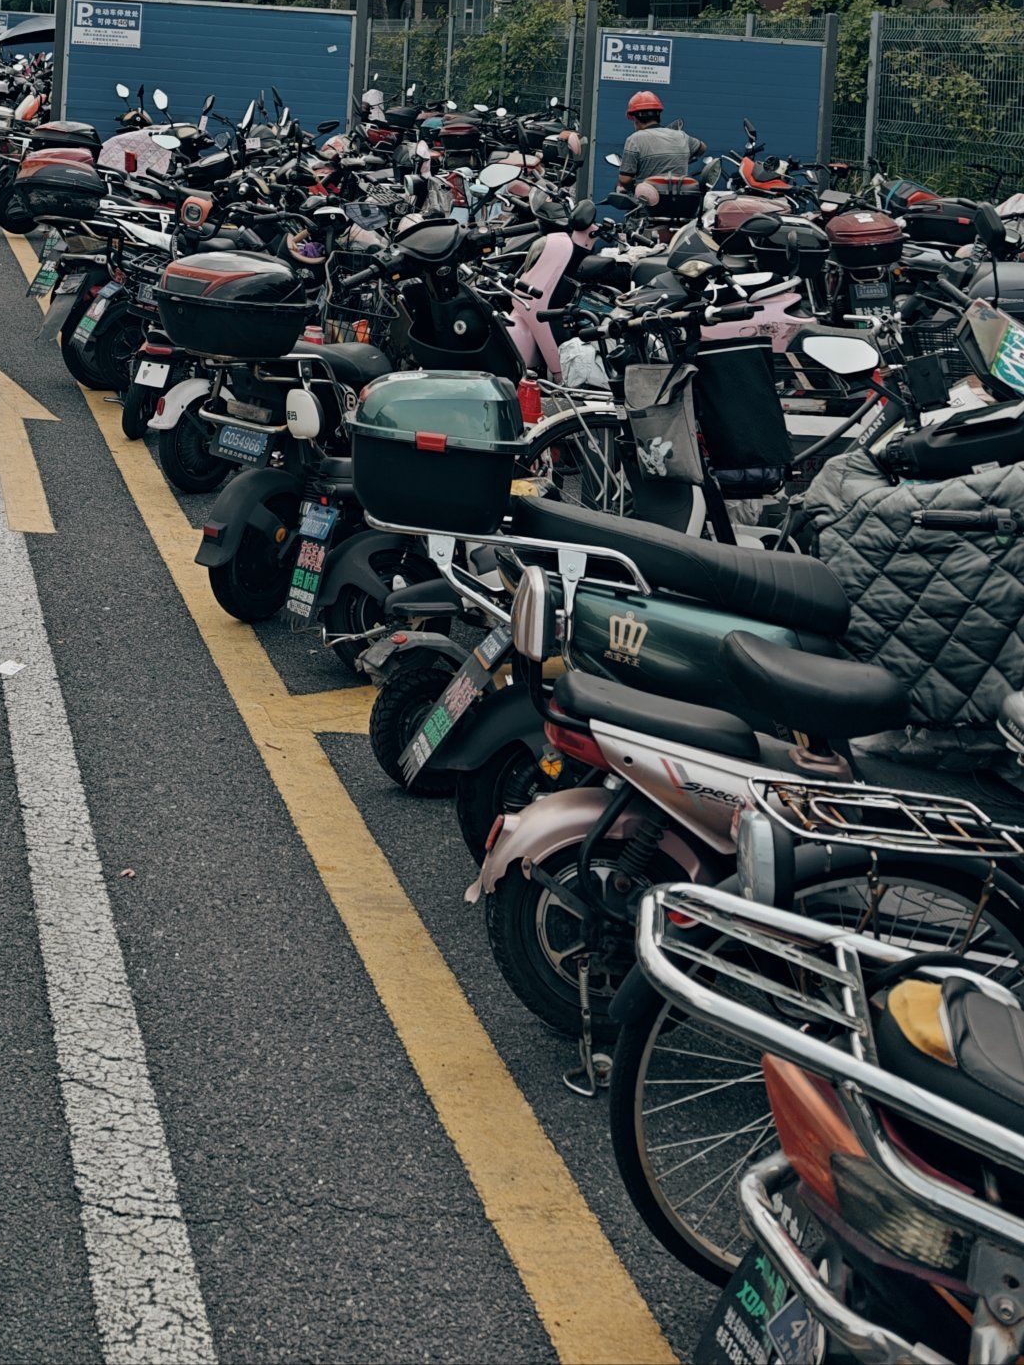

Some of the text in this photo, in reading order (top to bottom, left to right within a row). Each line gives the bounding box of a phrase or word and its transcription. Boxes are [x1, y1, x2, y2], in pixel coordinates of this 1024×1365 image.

[76, 3, 94, 26] P
[95, 8, 139, 18] 电动车停放处
[606, 38, 624, 62] P
[625, 43, 669, 54] 电动车停放处
[858, 412, 886, 445] GIANT
